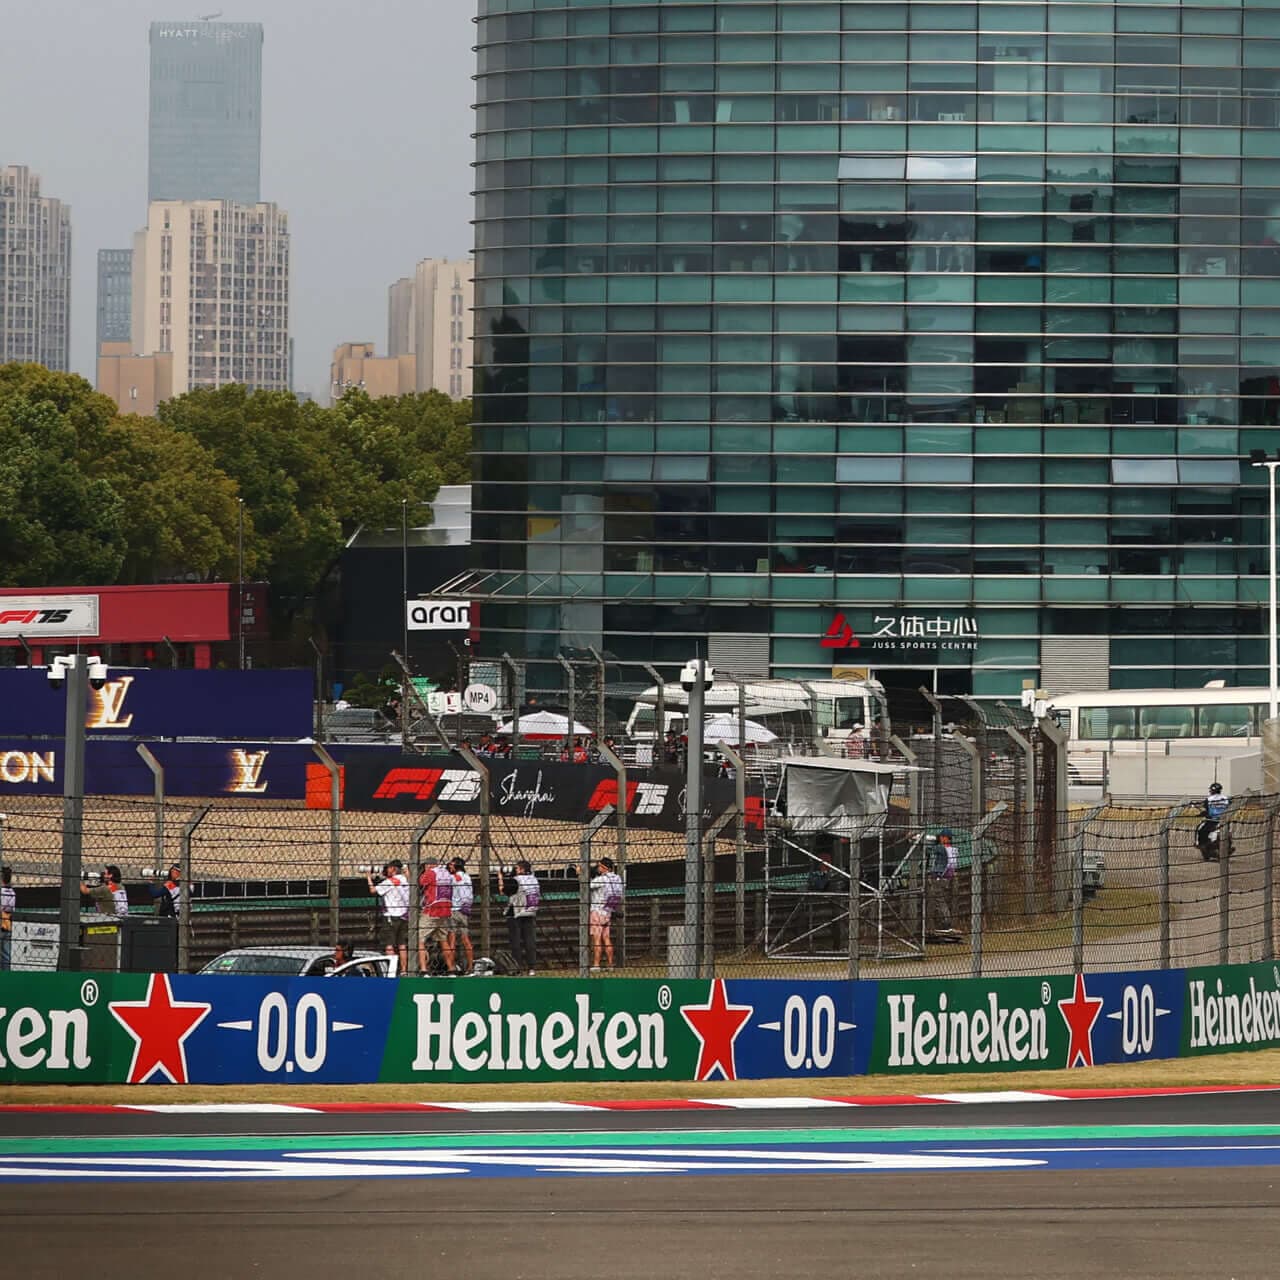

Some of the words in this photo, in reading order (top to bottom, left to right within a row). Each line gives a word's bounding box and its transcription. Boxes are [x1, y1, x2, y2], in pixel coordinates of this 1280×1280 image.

[159, 29, 198, 38] HYATT
[941, 642, 978, 650] CENTRE
[470, 691, 489, 704] MP4
[257, 992, 327, 1072] 0.0
[412, 993, 668, 1070] Heineken
[784, 995, 836, 1070] 0.0
[887, 992, 1049, 1067] Heineken
[1122, 983, 1154, 1055] 0.0
